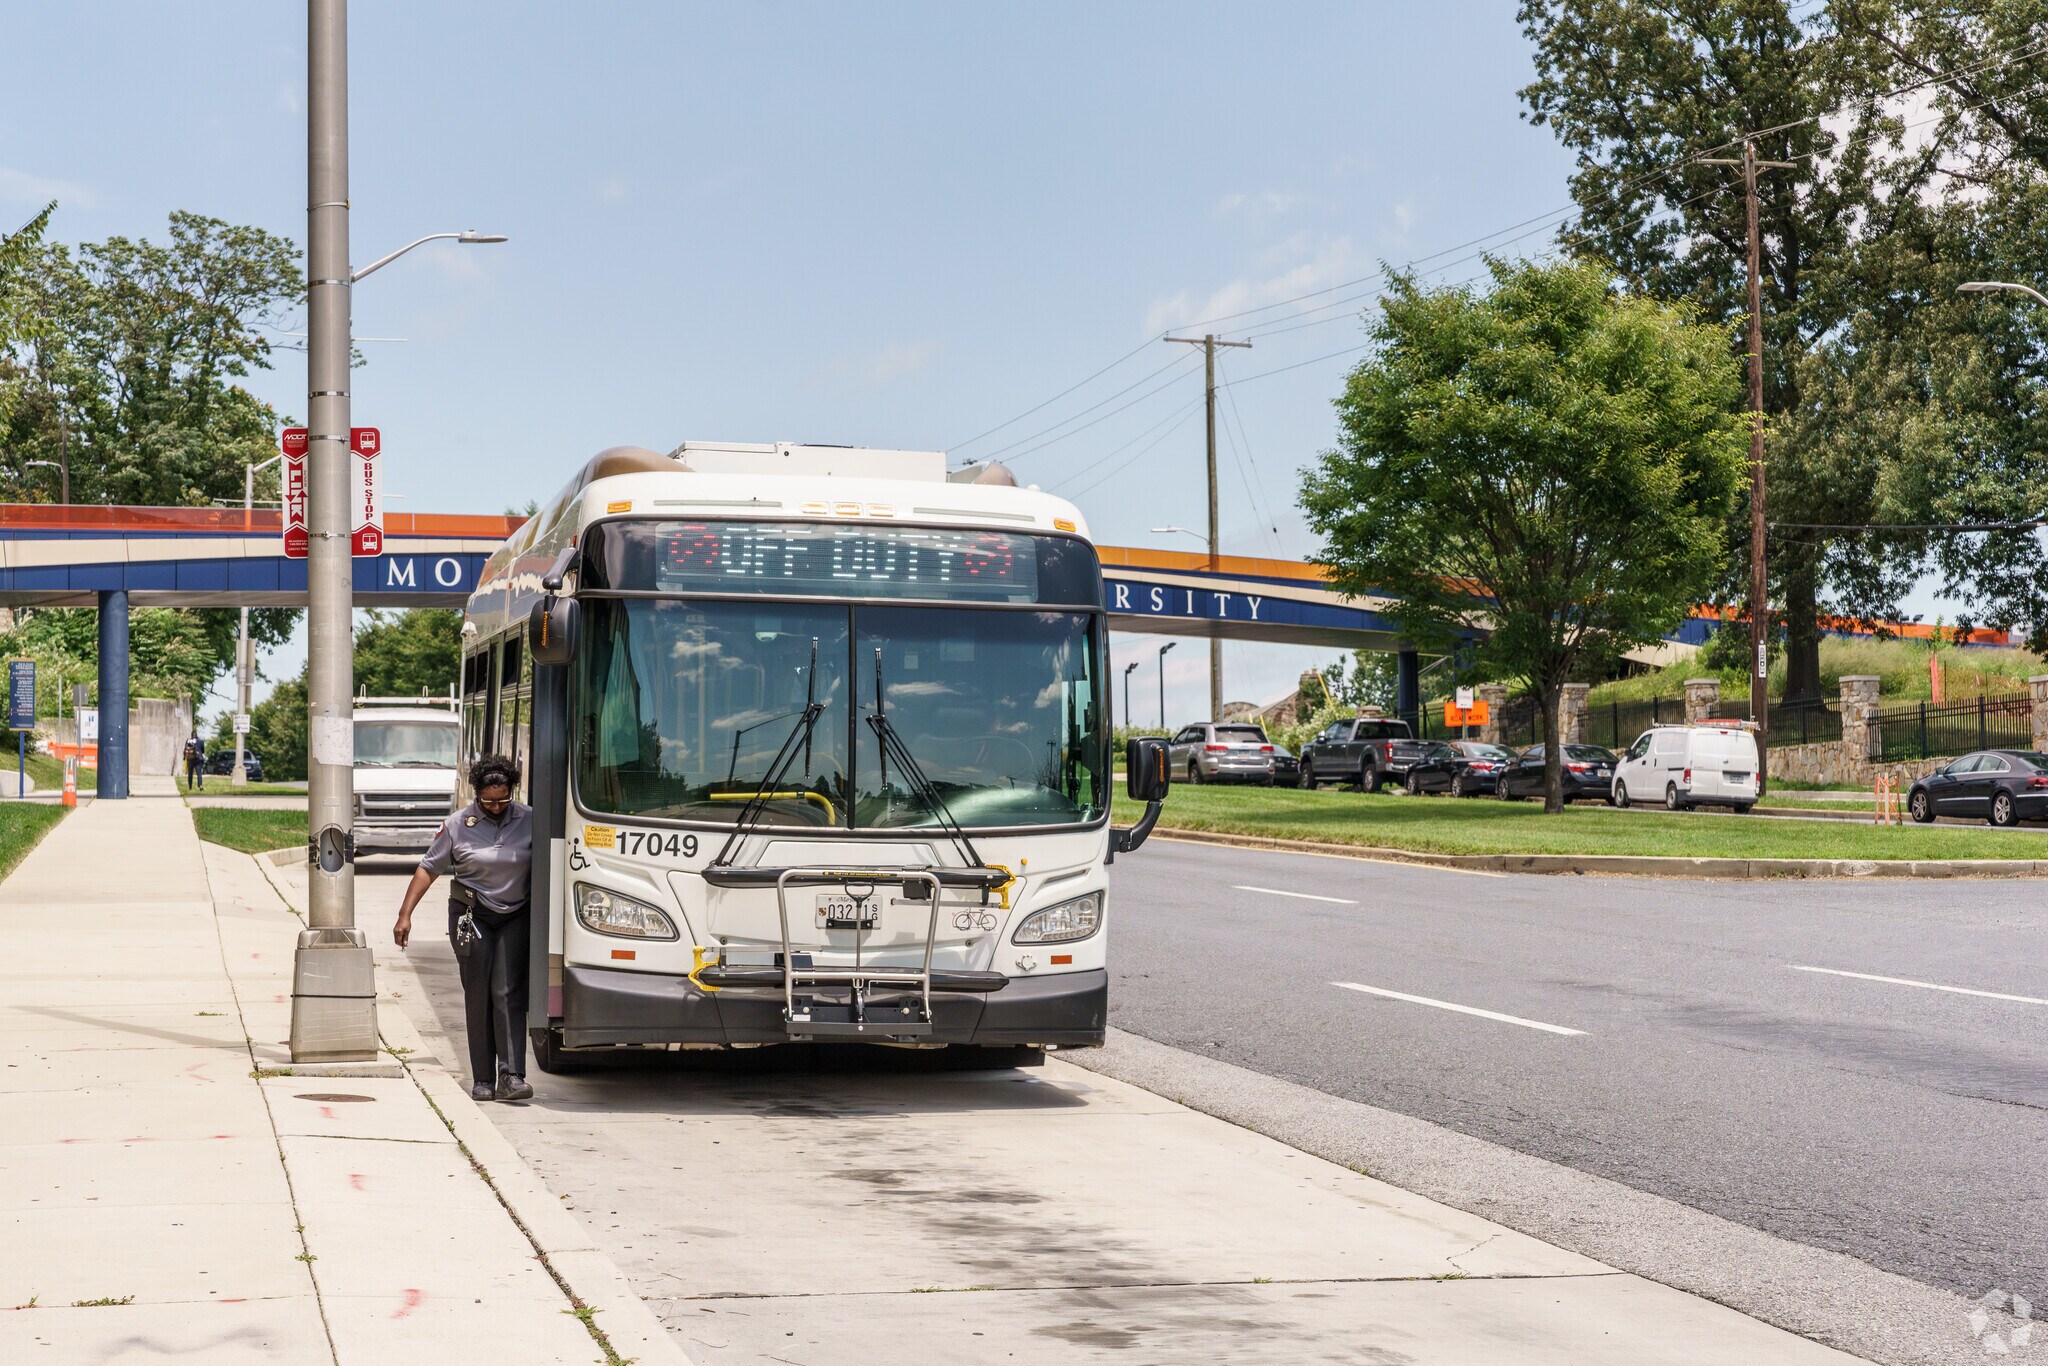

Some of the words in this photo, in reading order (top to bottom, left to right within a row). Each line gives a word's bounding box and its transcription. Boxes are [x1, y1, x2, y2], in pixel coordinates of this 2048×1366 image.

[364, 462, 373, 486] BUS
[365, 489, 374, 520] STOP
[721, 528, 812, 575] OFF
[832, 532, 962, 580] DUTY
[386, 557, 488, 587] MO
[616, 831, 699, 858] 17049
